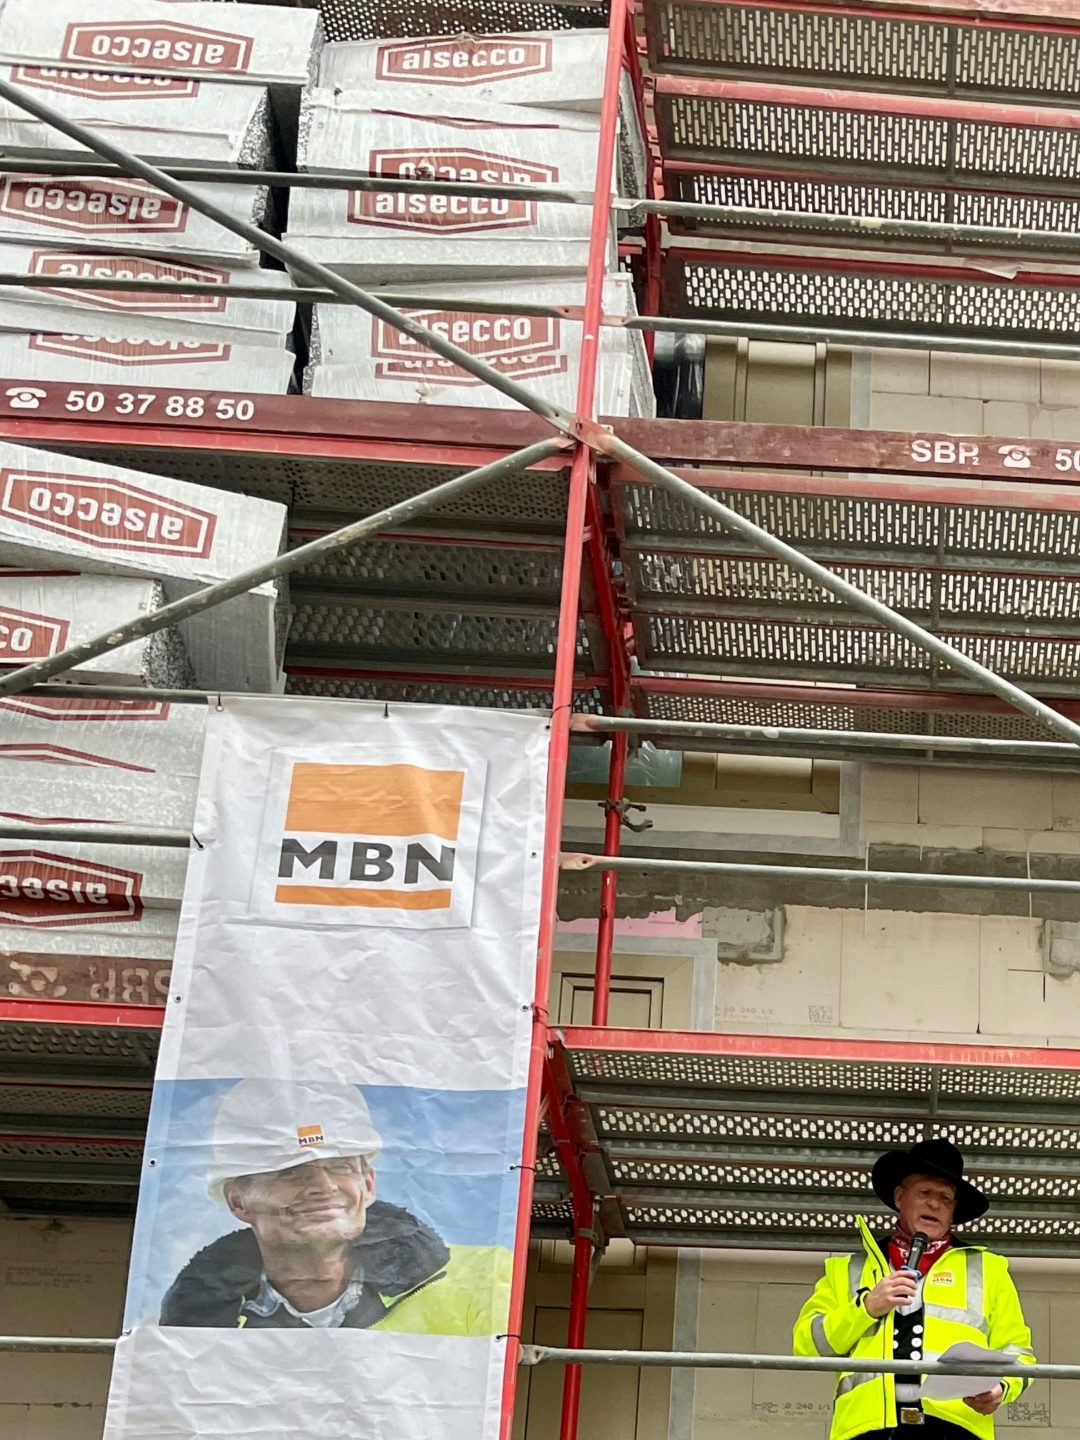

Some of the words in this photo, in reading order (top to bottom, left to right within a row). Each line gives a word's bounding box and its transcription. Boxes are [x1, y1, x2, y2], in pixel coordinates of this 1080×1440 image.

[91, 35, 225, 65] alsecco
[402, 47, 525, 70] alsecco
[25, 187, 162, 220] alsecco
[65, 390, 105, 412] 50
[115, 393, 156, 415] 37
[165, 396, 205, 418] 88
[215, 399, 255, 421] 50
[29, 487, 184, 540] alsecco
[277, 838, 457, 884] MBN
[299, 1136, 324, 1144] MBN
